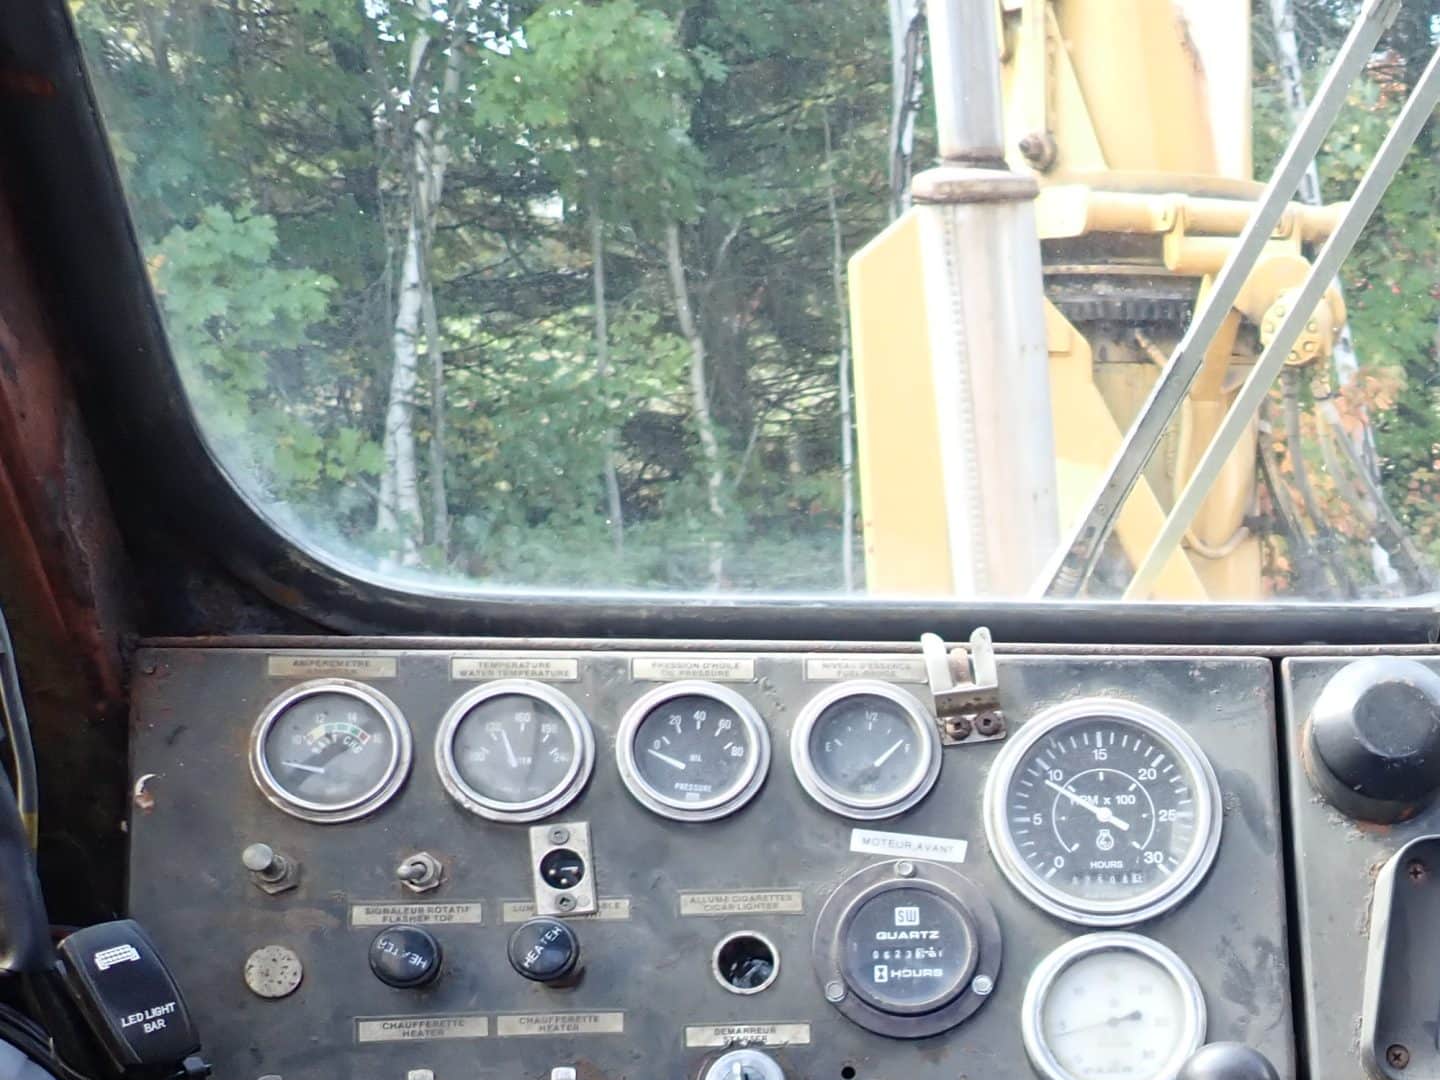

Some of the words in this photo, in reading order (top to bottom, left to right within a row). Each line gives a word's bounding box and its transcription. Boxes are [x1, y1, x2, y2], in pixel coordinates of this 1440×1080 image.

[459, 669, 498, 677] WATER
[669, 714, 683, 726] 20
[692, 710, 707, 722] 40
[718, 718, 732, 730] 60
[653, 739, 661, 750] 0
[825, 741, 832, 752] E
[904, 742, 911, 753] F
[730, 746, 744, 757] 80
[1092, 749, 1108, 761] 15
[1047, 769, 1064, 782] 10
[1137, 768, 1158, 780] 20
[1115, 794, 1137, 805] 100
[1032, 814, 1043, 826] 5
[1158, 809, 1177, 822] 25
[861, 836, 912, 850] MOTEUR
[916, 842, 954, 854] AVANT
[1053, 856, 1065, 868] 0
[1143, 851, 1164, 864] 30
[1089, 860, 1123, 869] HOURS
[689, 895, 730, 905] ALLUME
[731, 893, 793, 903] CIGARETTES
[364, 906, 425, 916] SIGNALEUR
[425, 905, 471, 915] ROTATIF
[703, 903, 737, 912] CIGAR
[738, 902, 780, 911] LIGHTER
[382, 914, 431, 923] FLASHER
[432, 914, 454, 923] TOP
[875, 930, 941, 941] QUARTZ
[375, 936, 428, 970] HEATER
[522, 925, 563, 969] HEATER
[890, 968, 944, 979] HOURS
[120, 1011, 144, 1028] LED
[145, 1001, 177, 1020] LIGHT
[518, 1015, 600, 1026] CHAUFFERETTE
[143, 1019, 167, 1034] BAR
[381, 1019, 466, 1031] CHAUFFERETTE
[537, 1023, 580, 1032] HEATER
[713, 1026, 777, 1036] DEMARREUR
[401, 1028, 445, 1038] HEATER
